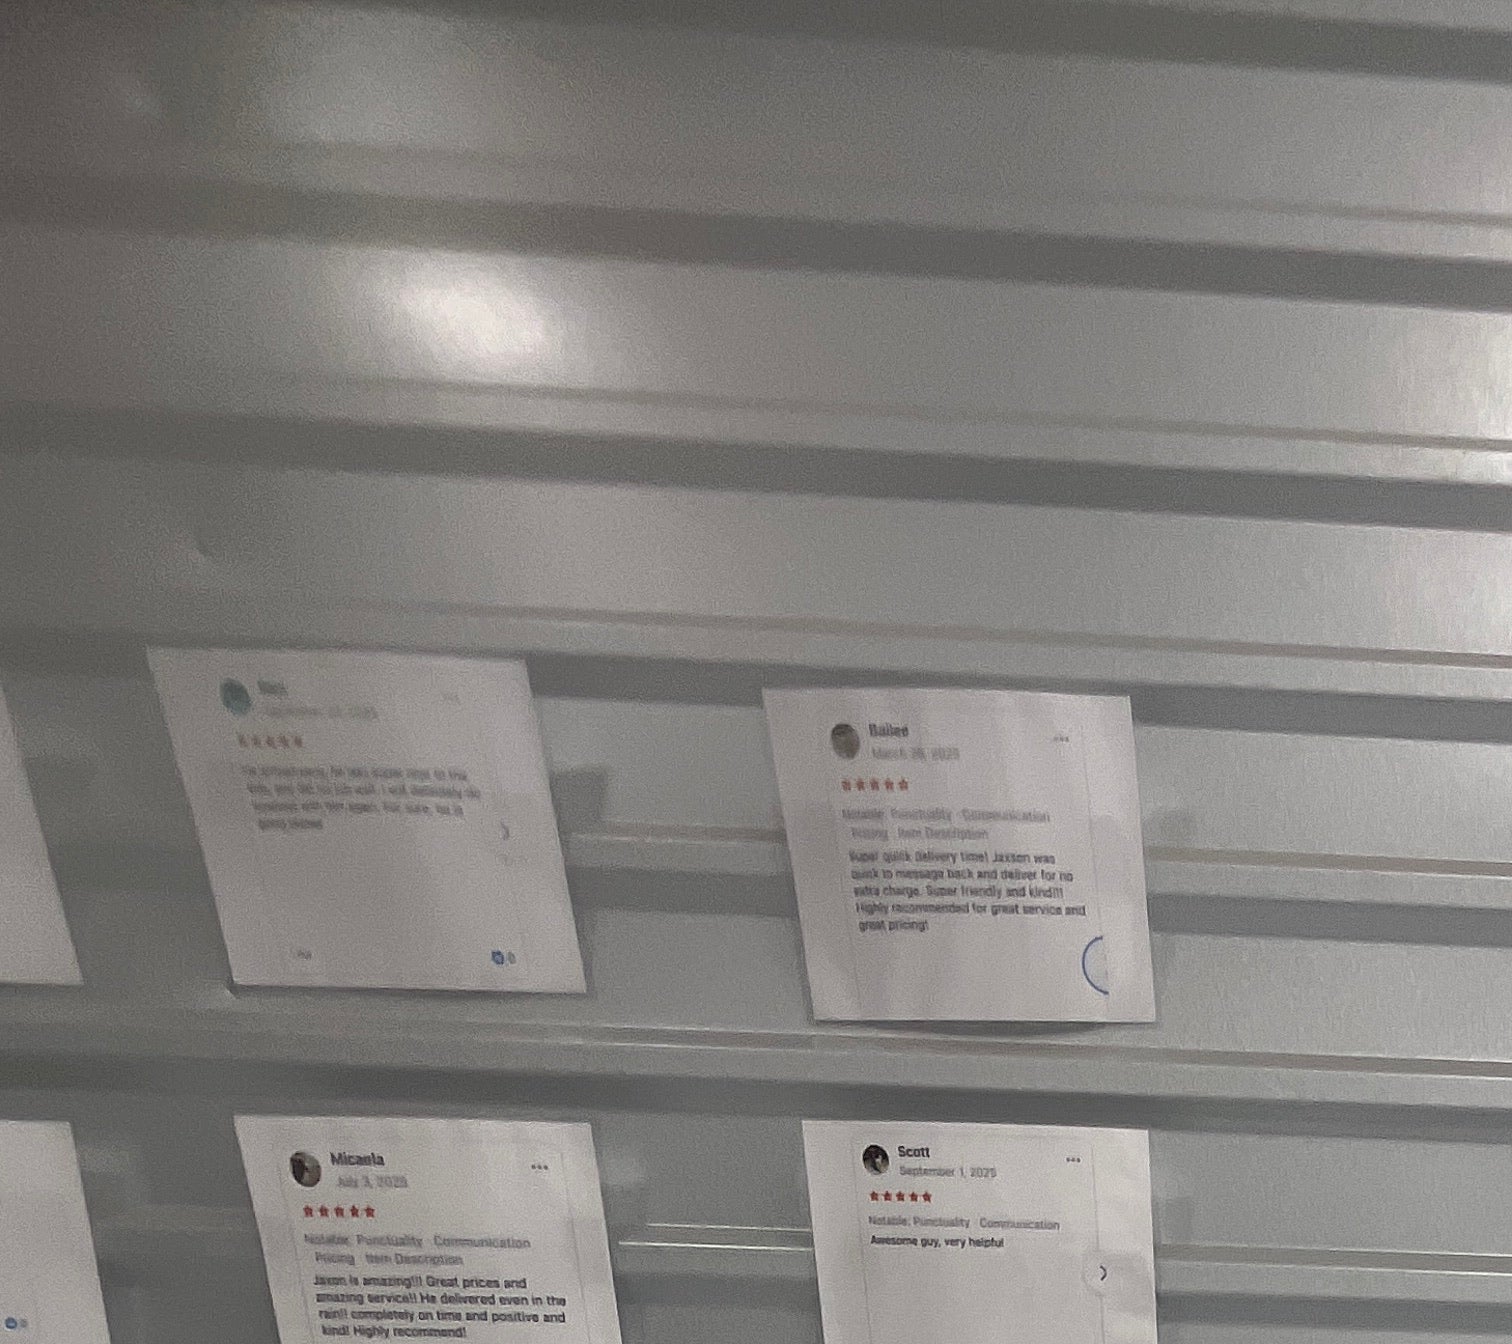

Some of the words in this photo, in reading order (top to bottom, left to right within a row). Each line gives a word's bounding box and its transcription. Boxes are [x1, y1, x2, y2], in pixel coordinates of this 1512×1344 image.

[977, 870, 997, 879] and
[1006, 887, 1025, 897] and
[991, 904, 1019, 915] great
[1065, 906, 1086, 916] and
[898, 1146, 930, 1158] Scott
[330, 1152, 385, 1166] Micaela
[913, 1216, 970, 1229] Punctuality
[979, 1218, 1060, 1231] Communication
[871, 1235, 917, 1246] Awesome
[921, 1236, 941, 1248] guy,
[944, 1237, 965, 1249] very
[969, 1236, 1004, 1249] helpful
[426, 1276, 459, 1287] Great
[463, 1277, 500, 1289] prices
[504, 1277, 527, 1289] and
[421, 1293, 436, 1304] He
[440, 1294, 496, 1306] delivered
[499, 1295, 528, 1306] even
[532, 1295, 542, 1306] in
[547, 1296, 566, 1306] the
[466, 1311, 488, 1322] and
[492, 1311, 539, 1323] positive
[543, 1312, 566, 1323] and
[353, 1326, 389, 1339] Highly
